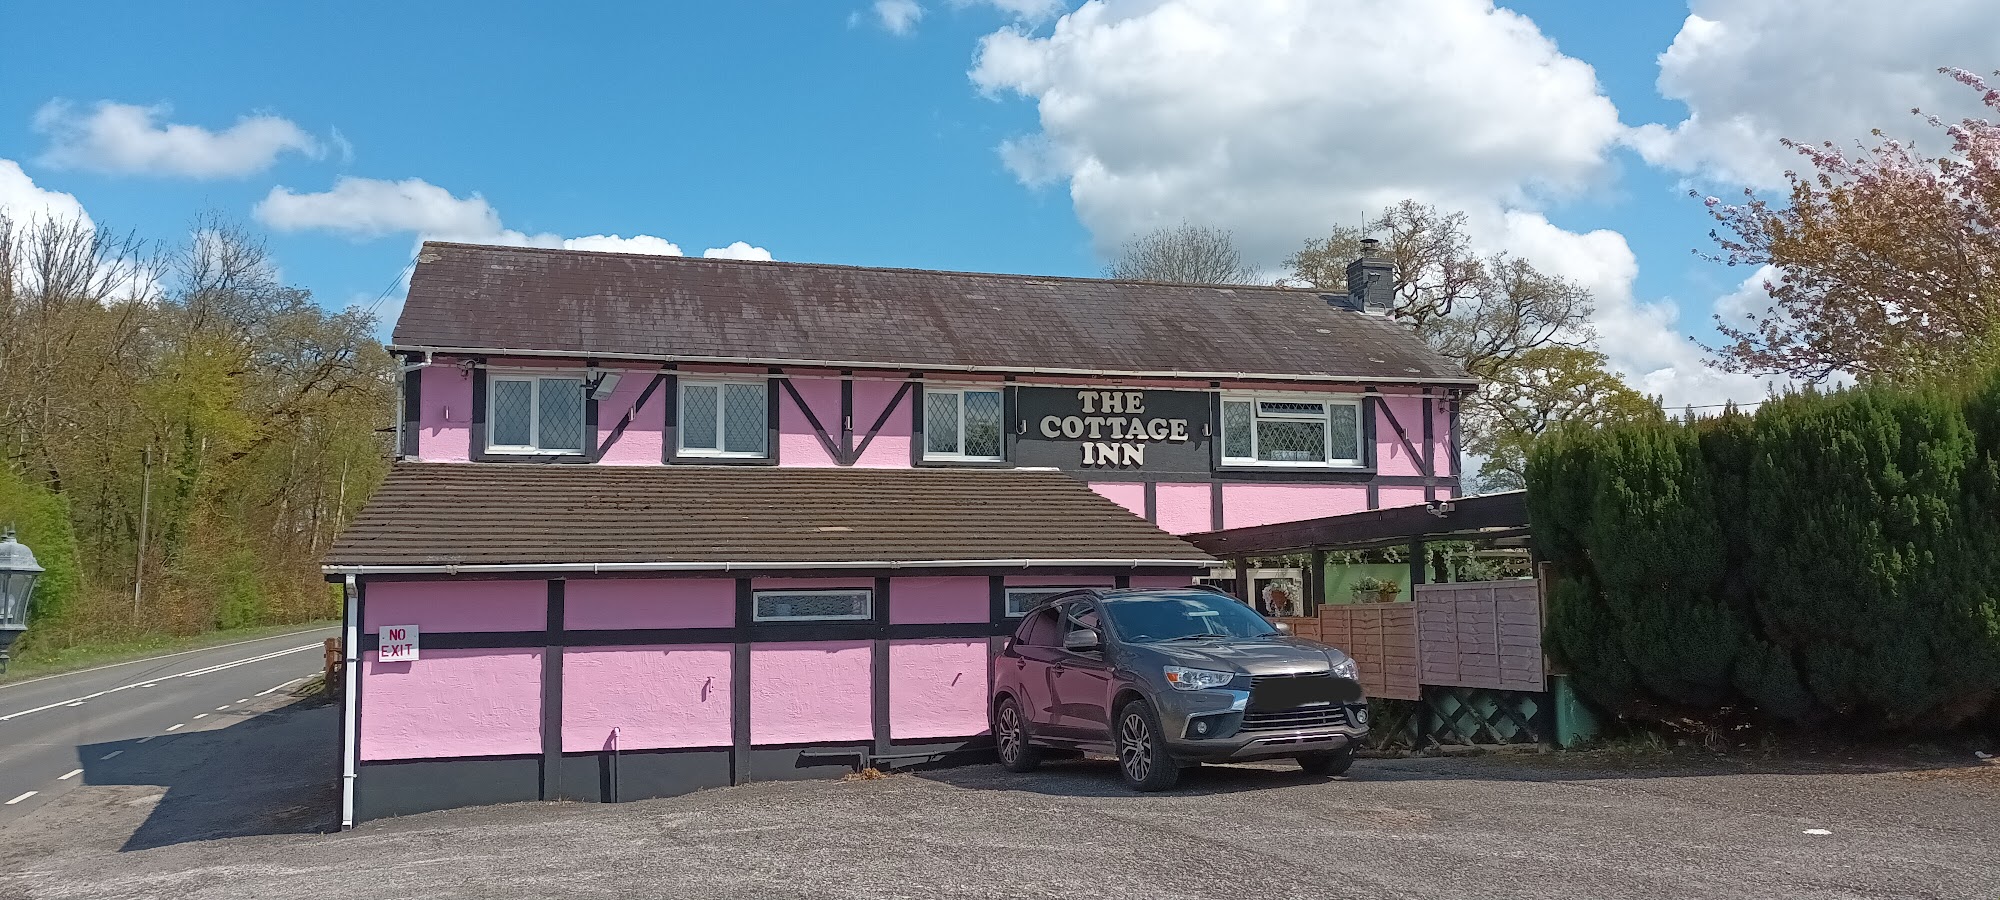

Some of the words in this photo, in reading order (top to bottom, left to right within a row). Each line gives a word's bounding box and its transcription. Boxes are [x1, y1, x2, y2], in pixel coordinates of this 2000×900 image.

[1077, 391, 1145, 414] THE
[1040, 415, 1189, 441] COTTAGE
[1082, 442, 1146, 466] INN
[389, 628, 406, 641] NO
[381, 643, 413, 657] EXIT
